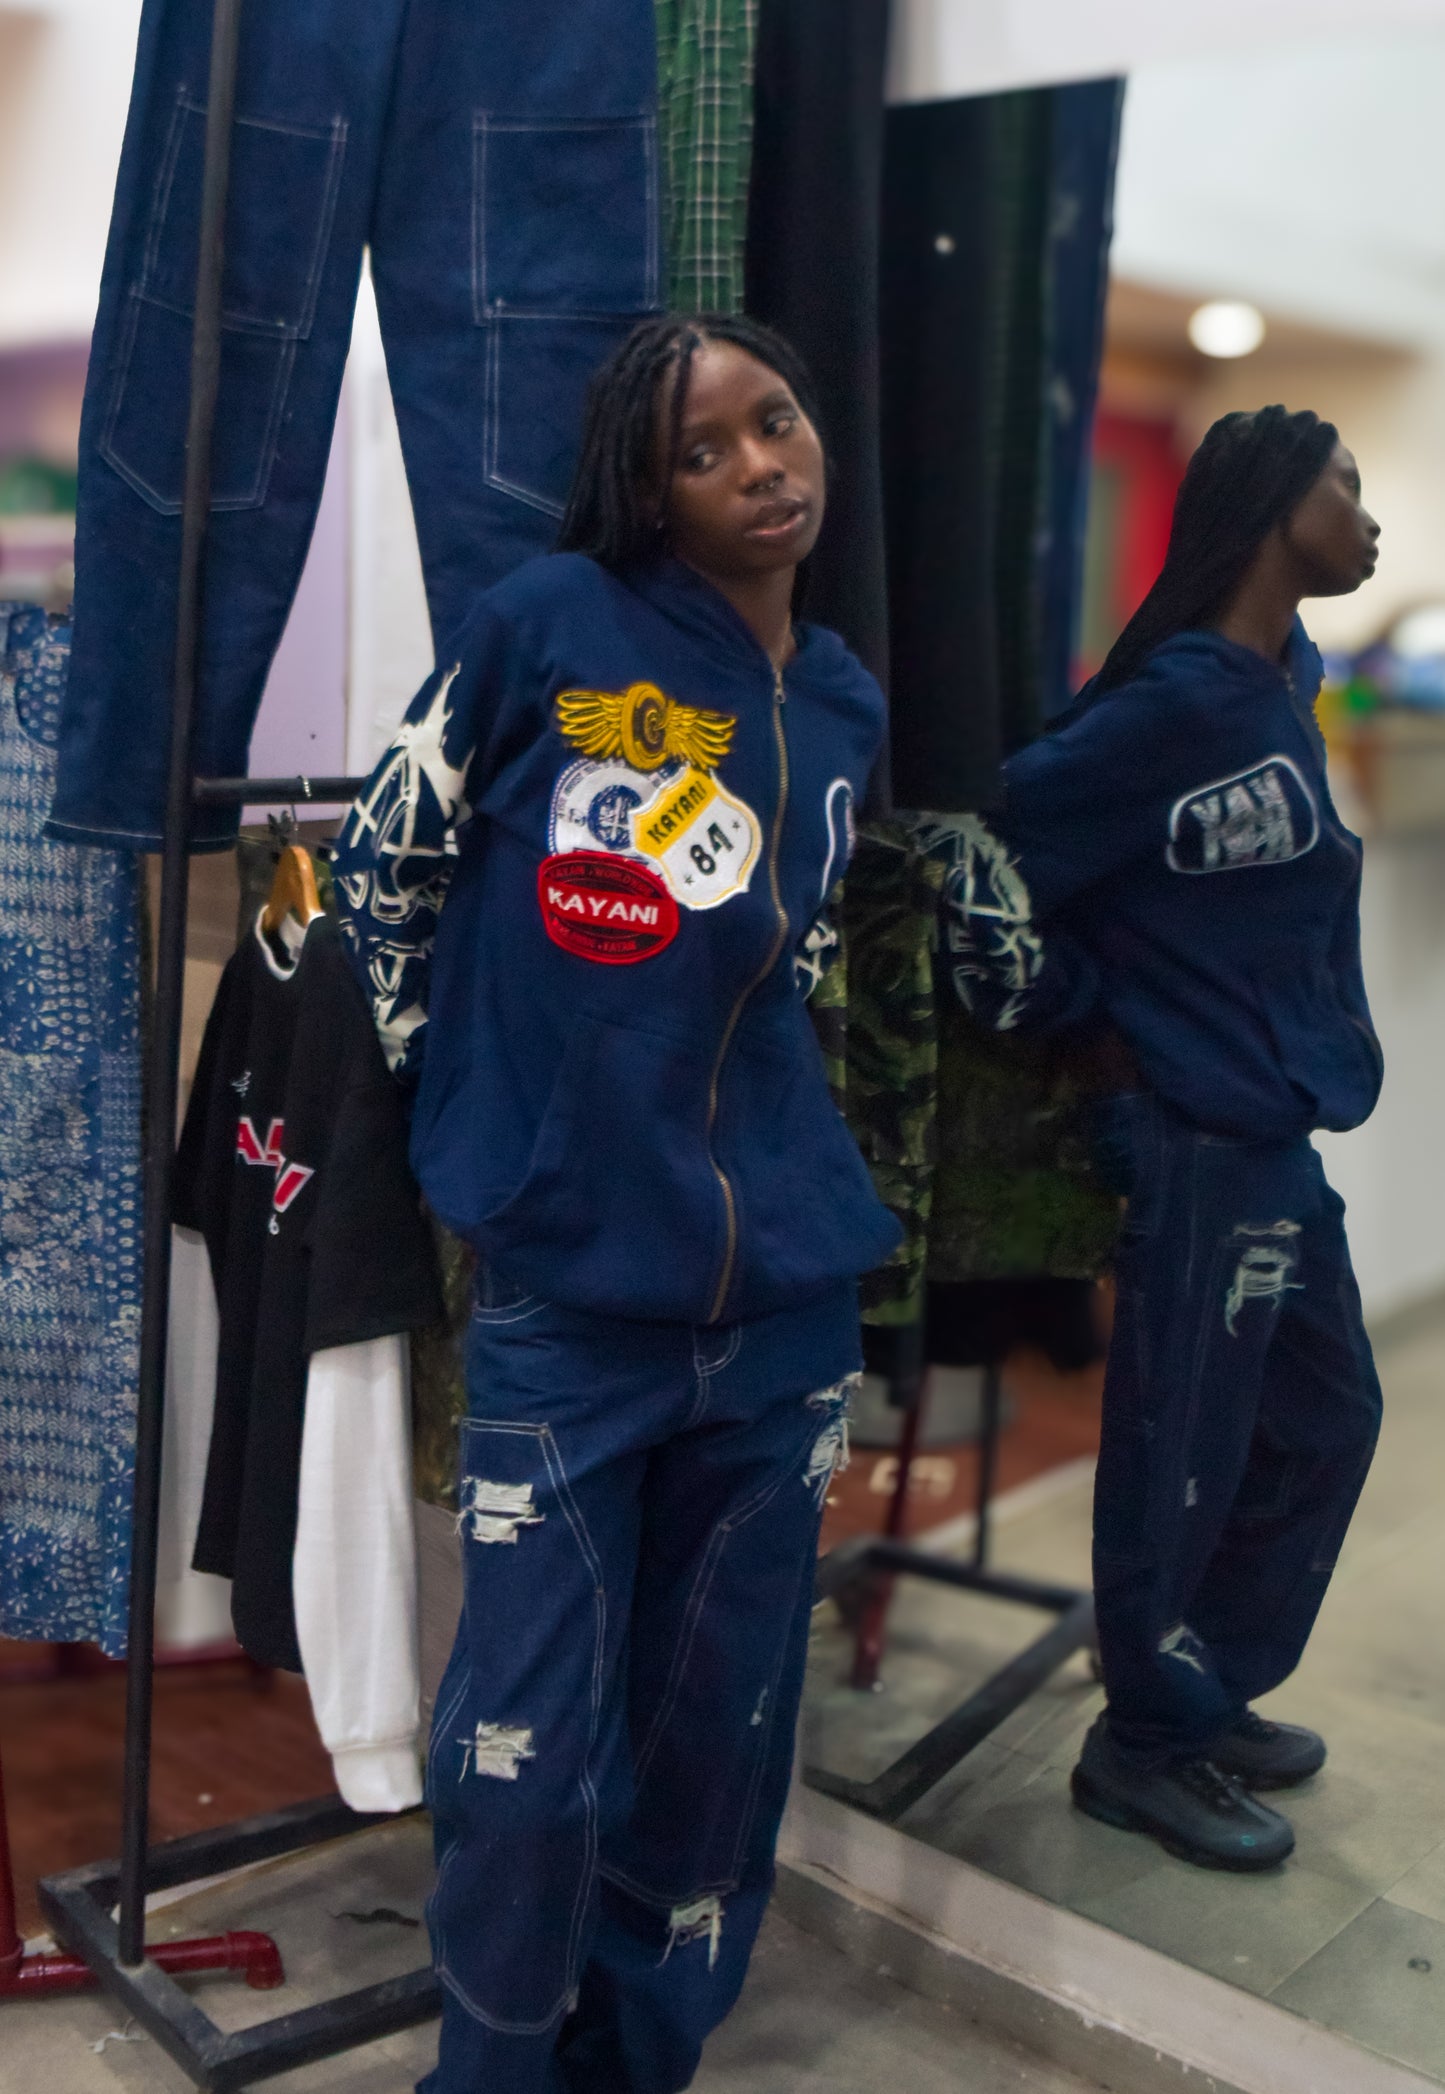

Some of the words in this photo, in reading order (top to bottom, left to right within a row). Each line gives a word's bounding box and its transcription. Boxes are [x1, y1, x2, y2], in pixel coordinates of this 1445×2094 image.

[647, 781, 707, 844] KAYANI
[690, 822, 735, 876] 84
[547, 886, 659, 925] KAYANI
